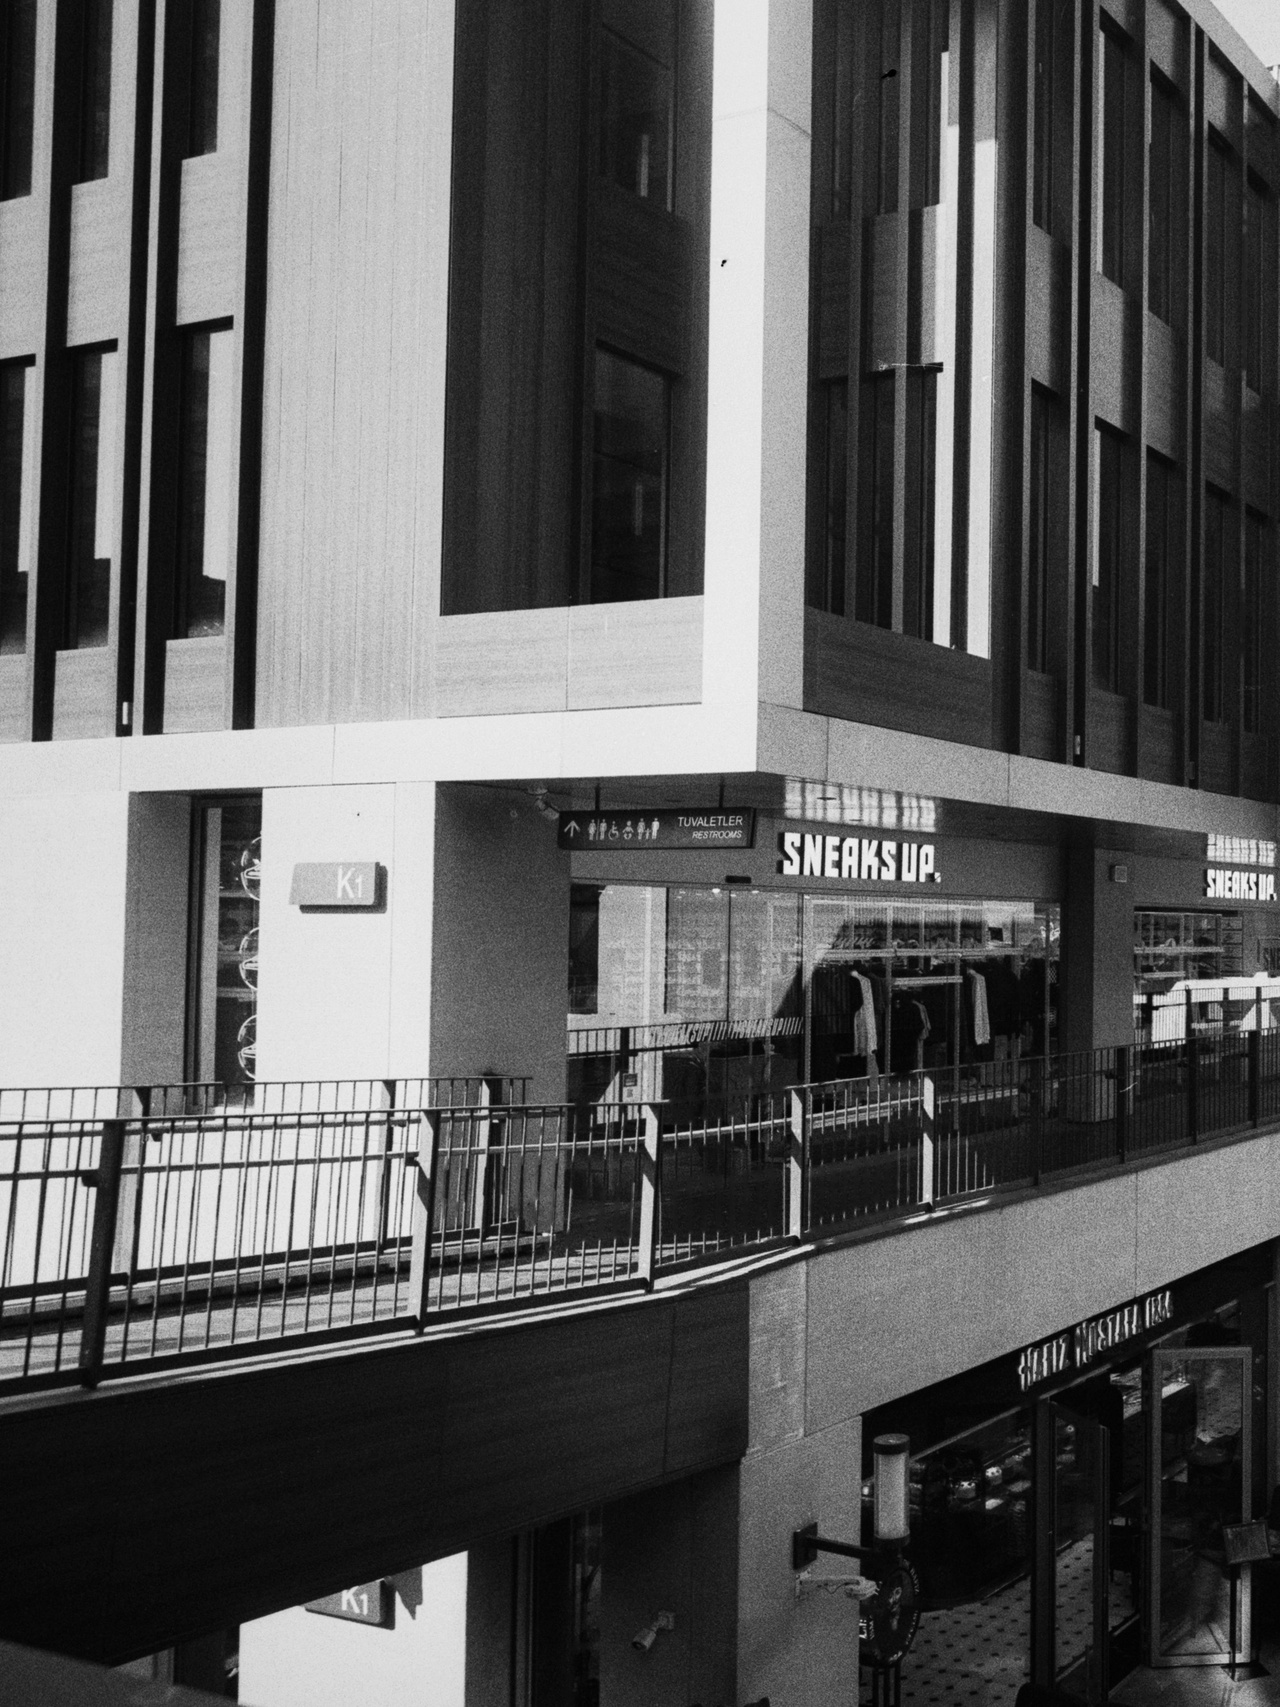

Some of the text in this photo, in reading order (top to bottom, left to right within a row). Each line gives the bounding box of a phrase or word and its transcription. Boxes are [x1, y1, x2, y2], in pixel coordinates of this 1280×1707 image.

[677, 815, 744, 827] TUVALETLER
[692, 830, 743, 839] RESTROOMS
[337, 865, 362, 899] K1
[341, 1585, 368, 1616] K1
